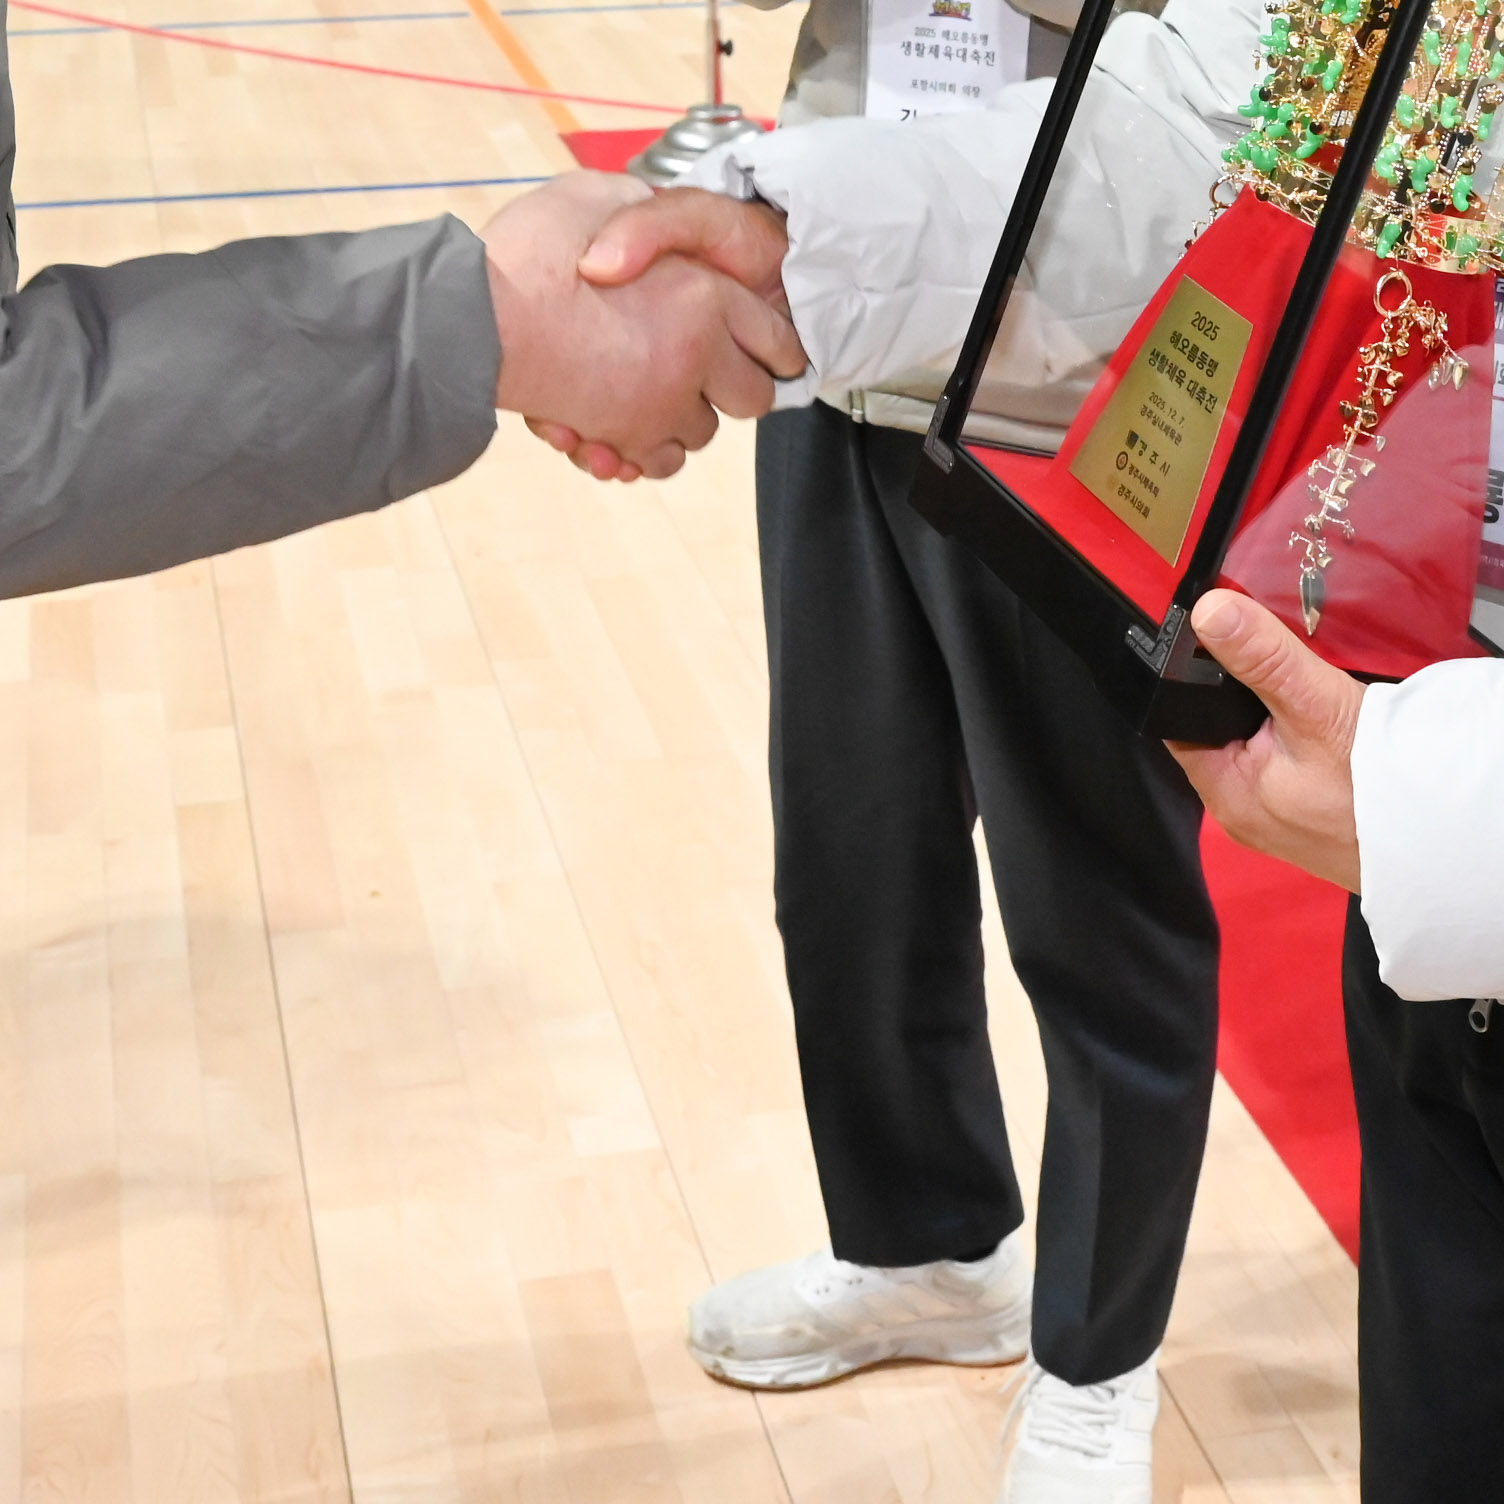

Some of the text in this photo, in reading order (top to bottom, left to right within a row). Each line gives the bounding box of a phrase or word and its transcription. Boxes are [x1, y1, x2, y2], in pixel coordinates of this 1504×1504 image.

[1190, 310, 1221, 341] 2025
[1169, 329, 1220, 378] 해오름동맹
[1148, 347, 1219, 415] 생활체육 대축전
[1148, 391, 1167, 414] 2025.
[1140, 404, 1183, 447] 경주실내체육관
[1117, 483, 1151, 519] 경주시의회
